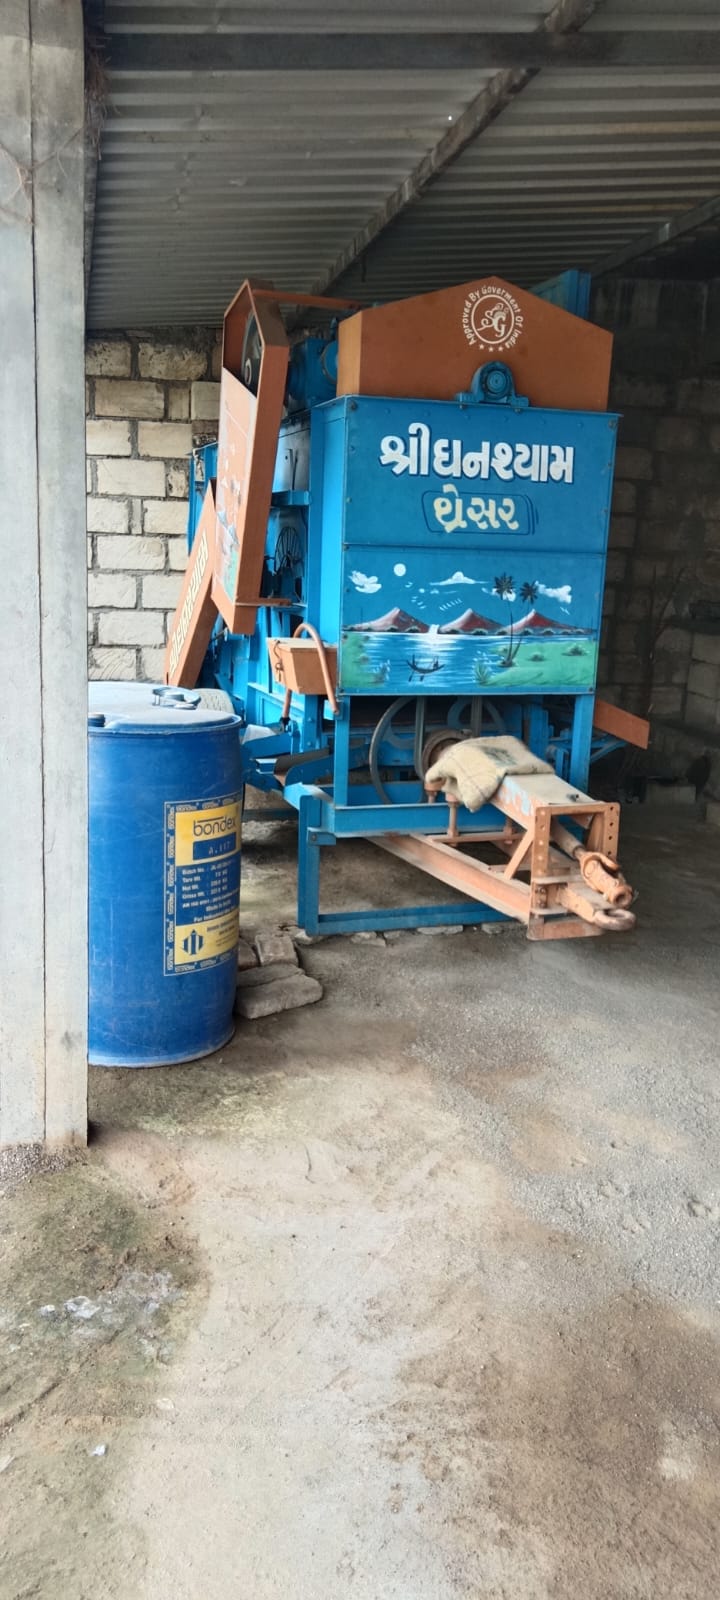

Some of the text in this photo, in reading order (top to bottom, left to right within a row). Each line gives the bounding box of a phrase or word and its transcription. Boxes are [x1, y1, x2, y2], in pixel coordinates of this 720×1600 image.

[462, 285, 524, 349] Approved By Goverment Of India
[433, 483, 519, 534] થ્રેસર
[193, 816, 237, 836] bondex
